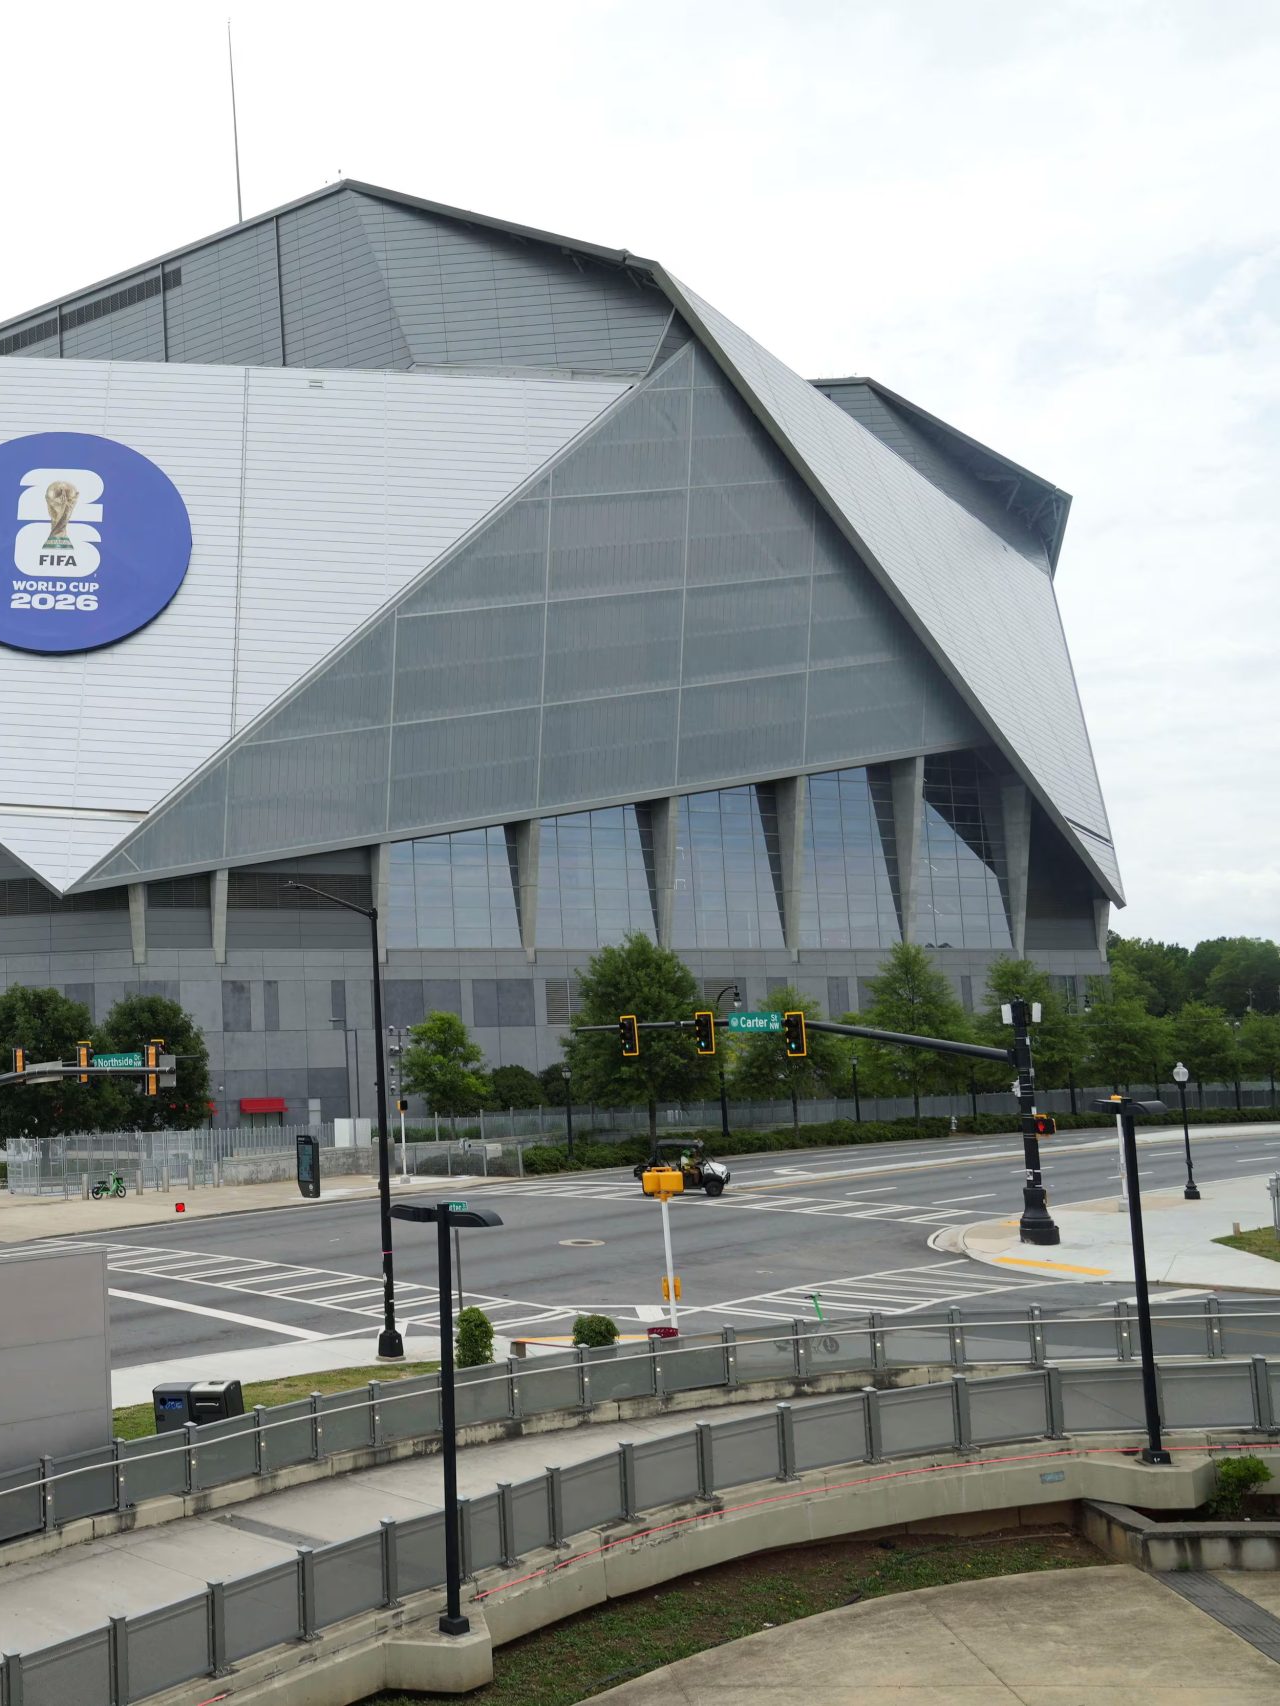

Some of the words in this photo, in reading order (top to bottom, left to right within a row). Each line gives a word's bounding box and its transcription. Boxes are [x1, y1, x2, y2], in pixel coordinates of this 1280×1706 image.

[39, 554, 77, 567] FIFA
[12, 580, 67, 591] WORLD
[69, 582, 100, 593] CUP
[10, 592, 99, 611] 2026
[740, 1016, 768, 1028] Carter
[770, 1014, 778, 1022] St
[769, 1022, 780, 1030] NW
[98, 1057, 133, 1067] Northside
